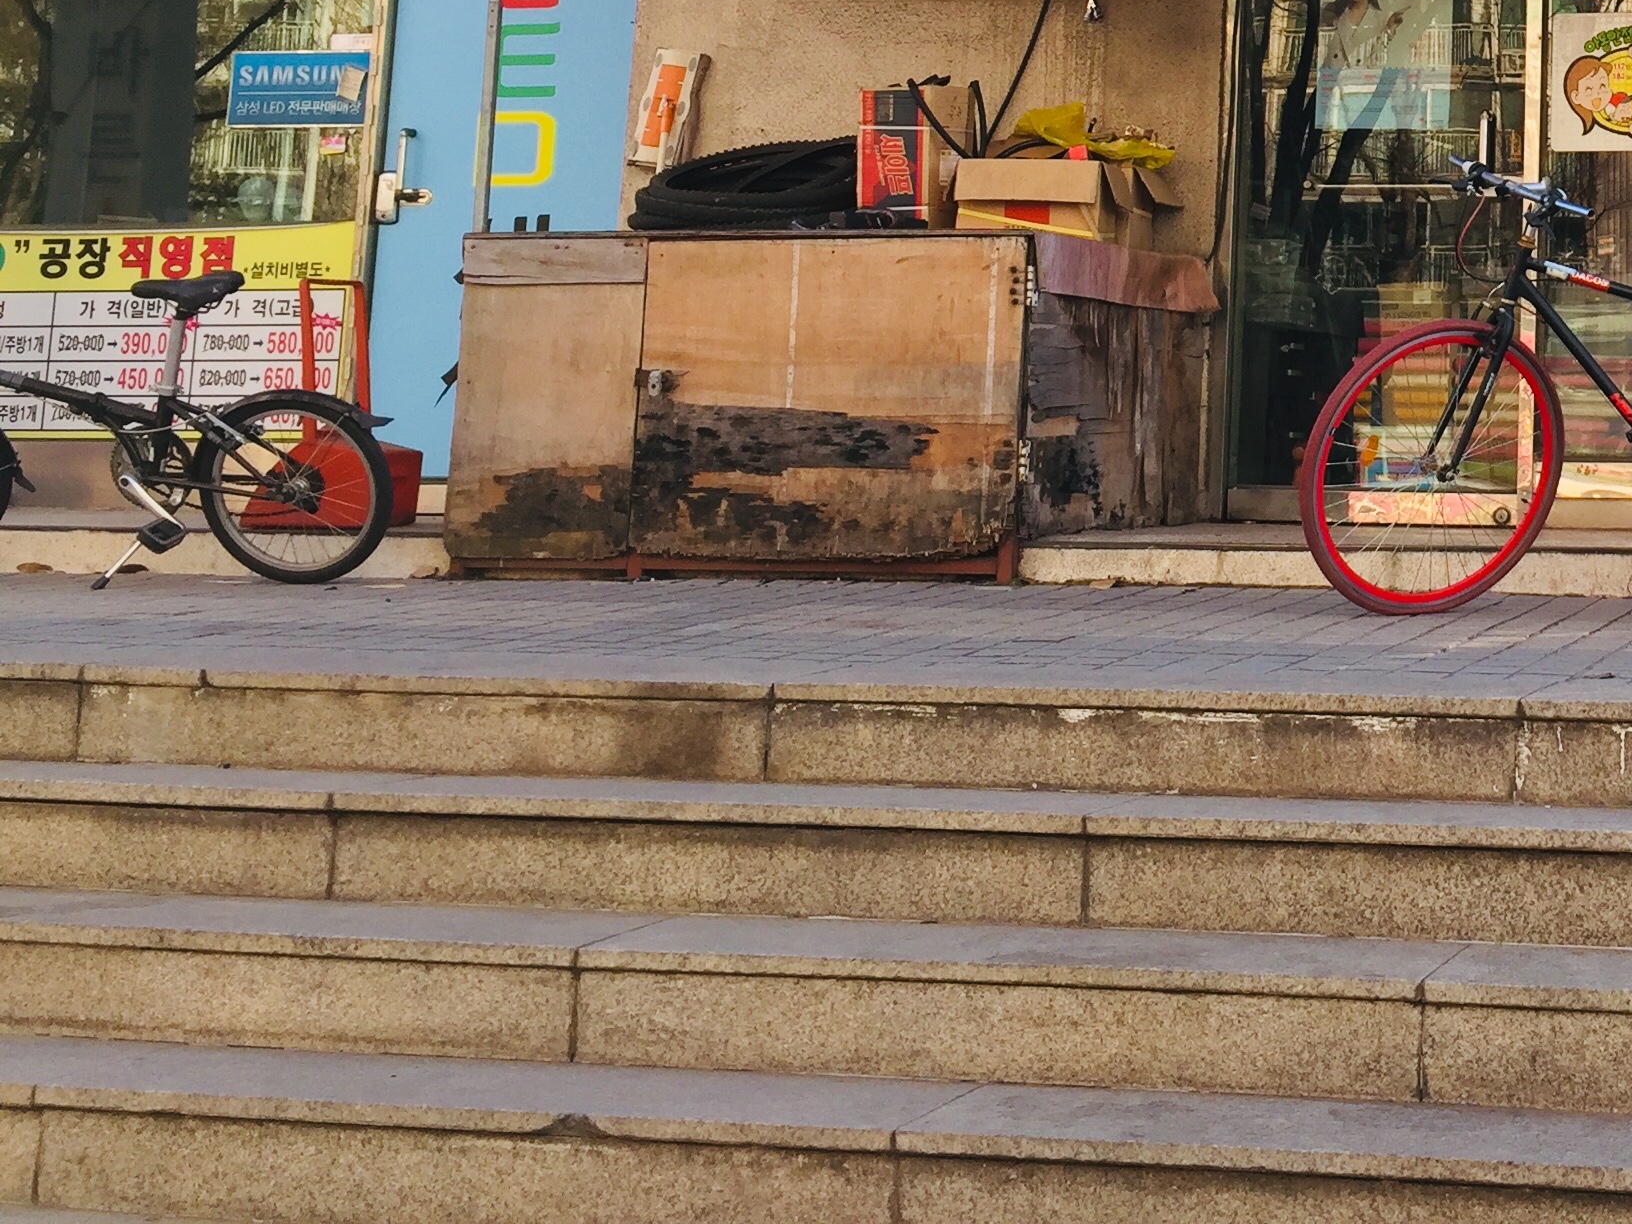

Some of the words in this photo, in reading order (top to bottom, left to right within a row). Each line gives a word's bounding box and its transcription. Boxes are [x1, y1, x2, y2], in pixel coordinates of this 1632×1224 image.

[240, 64, 348, 87] SAMSUN
[235, 100, 261, 116] 삼성
[263, 101, 286, 114] LED
[39, 237, 111, 279] 공장
[118, 235, 236, 280] 직영점
[120, 332, 188, 357] 390,00
[266, 331, 335, 357] 580,00
[263, 366, 332, 391] 650,00
